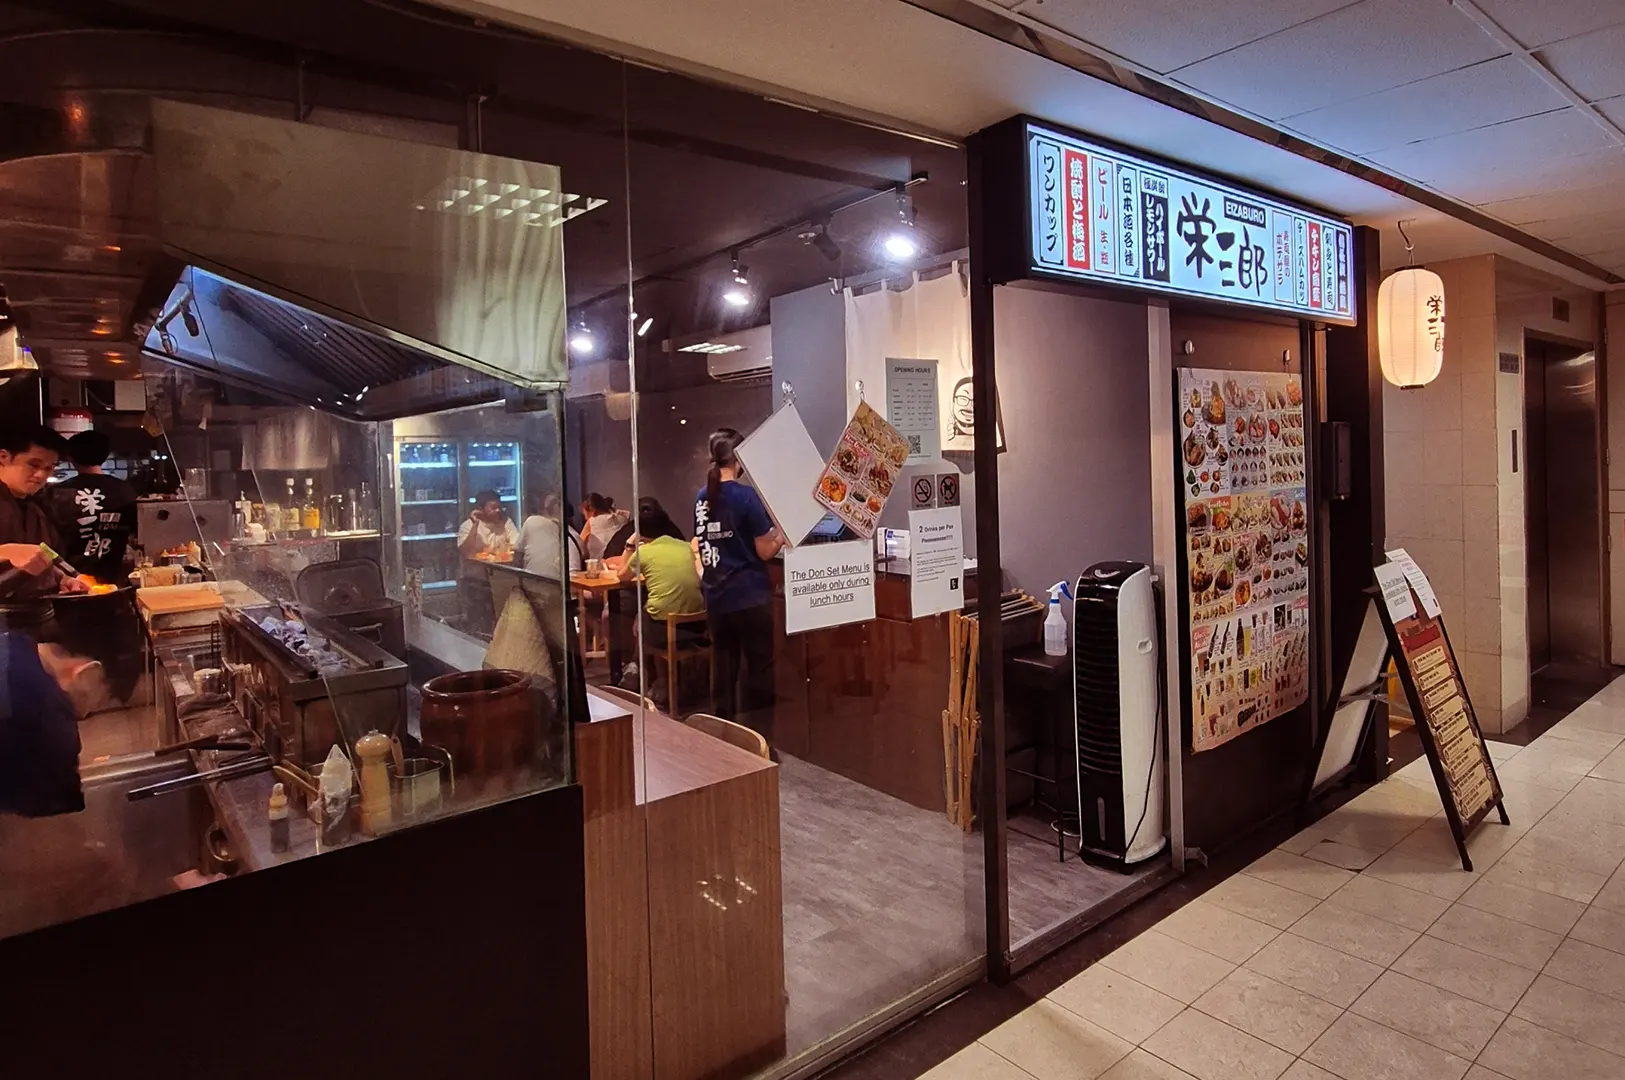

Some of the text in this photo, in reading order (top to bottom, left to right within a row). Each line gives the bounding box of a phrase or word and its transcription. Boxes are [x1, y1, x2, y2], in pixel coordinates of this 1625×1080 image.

[1043, 154, 1058, 252] ワンカップ
[1097, 166, 1109, 221] ビール
[1225, 200, 1265, 224] EIZABURO
[1146, 194, 1155, 276] レモンサワー
[1155, 203, 1165, 272] ハイボール
[894, 366, 915, 374] OPENING
[919, 525, 923, 533] 2
[791, 562, 870, 580] The Don Set Menu is
[792, 577, 870, 595] available only during
[810, 592, 854, 606] lunch hours
